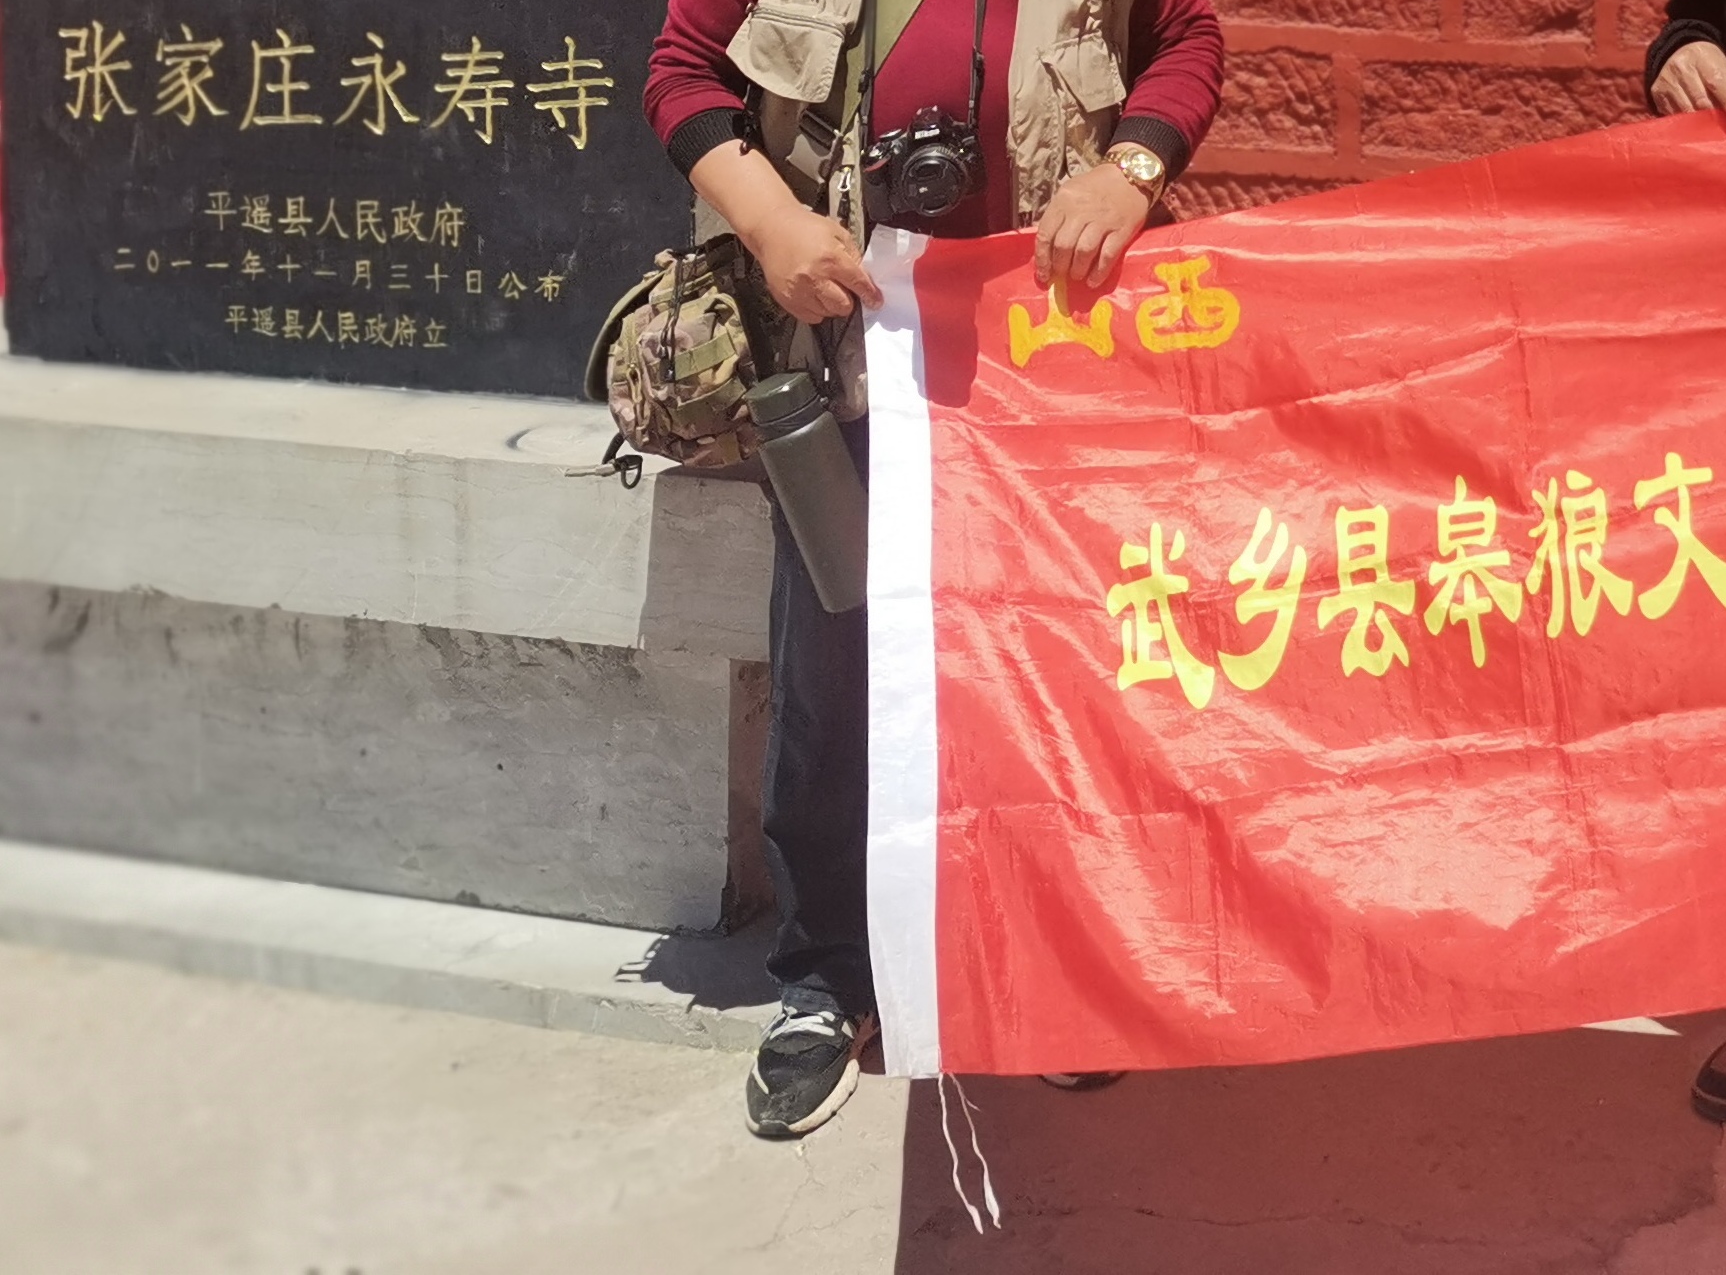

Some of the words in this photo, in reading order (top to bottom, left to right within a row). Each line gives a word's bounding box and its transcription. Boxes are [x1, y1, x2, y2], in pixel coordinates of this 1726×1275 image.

[58, 21, 615, 151] 张家庄永寿寺
[203, 191, 466, 247] 平遥县人民政府
[224, 305, 448, 350] 平遥县人民政府立
[1008, 255, 1240, 368] 山西
